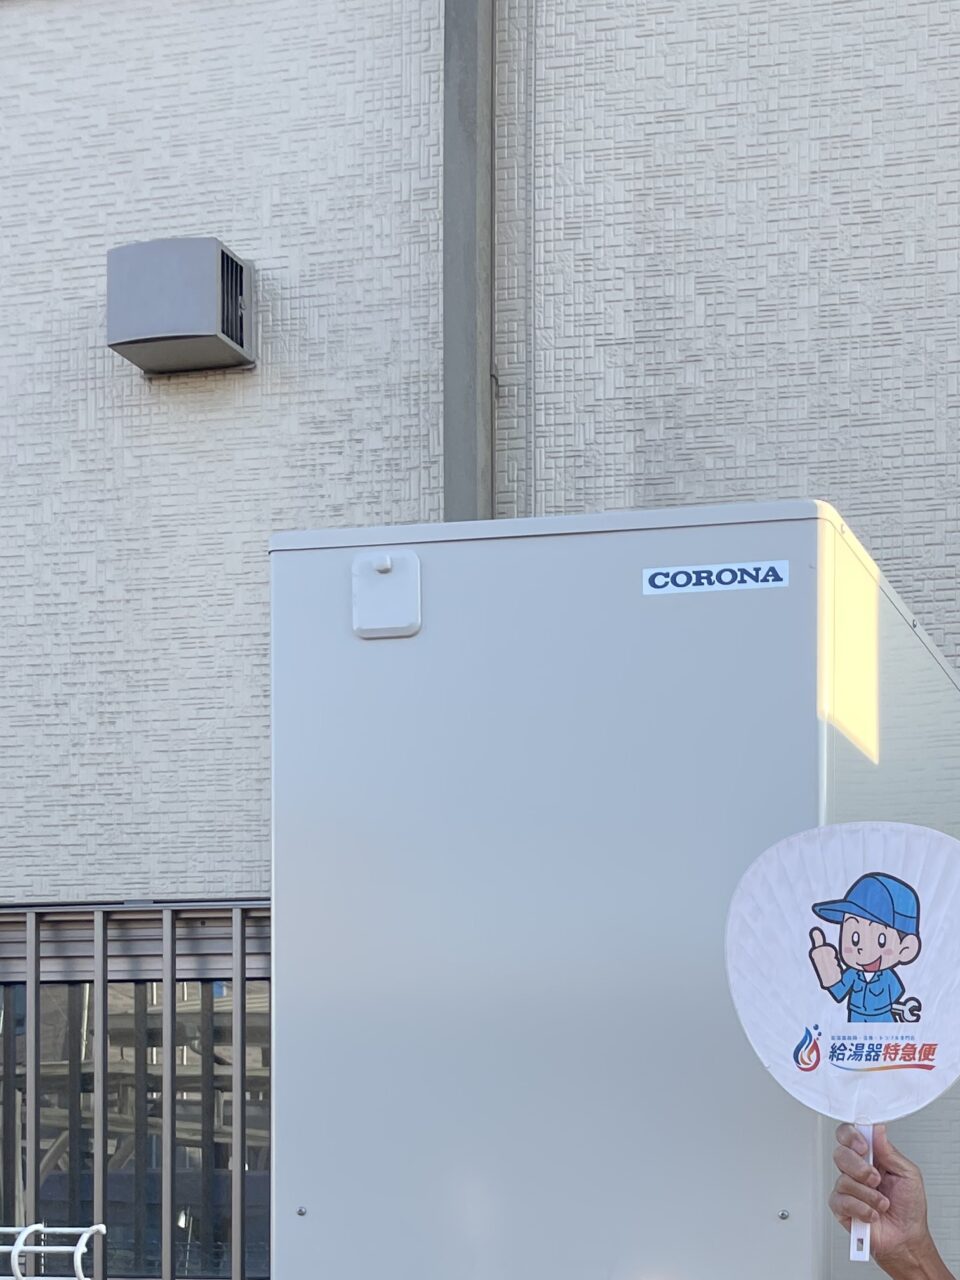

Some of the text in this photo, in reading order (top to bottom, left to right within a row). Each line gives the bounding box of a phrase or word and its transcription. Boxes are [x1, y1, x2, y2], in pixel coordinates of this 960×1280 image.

[648, 566, 784, 589] CORONA
[828, 1042, 939, 1062] 給湯器特急便
